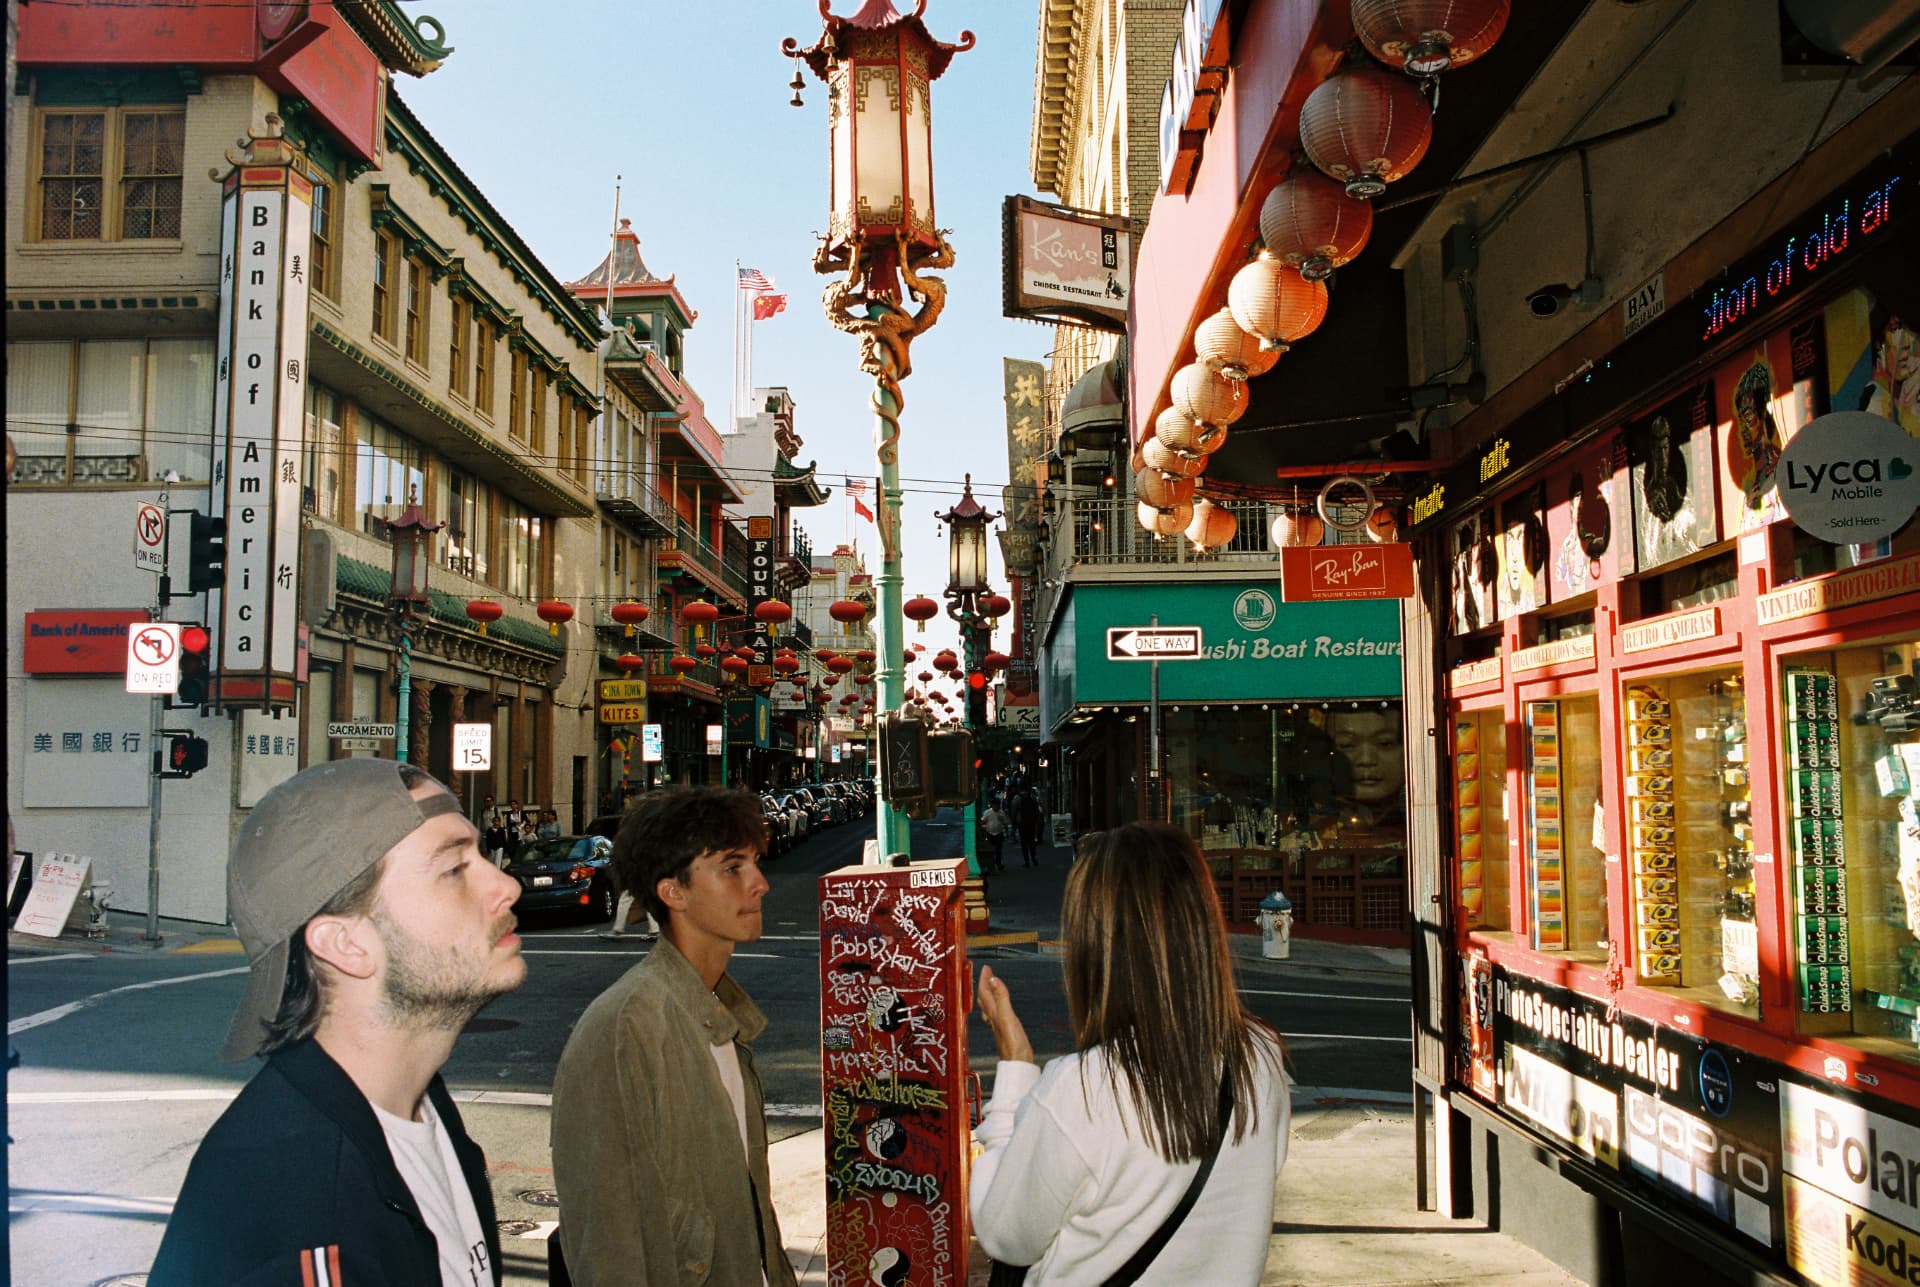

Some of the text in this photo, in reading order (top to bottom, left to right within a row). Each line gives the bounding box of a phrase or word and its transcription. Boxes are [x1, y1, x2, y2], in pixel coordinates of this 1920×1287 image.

[1030, 219, 1098, 269] Kan's
[1767, 236, 1796, 295] of
[1805, 199, 1848, 272] old
[1062, 285, 1102, 298] RESTAURANT
[1627, 279, 1659, 318] BAY
[237, 205, 268, 652] Bank of America
[1786, 459, 1882, 494] Lyca
[1832, 487, 1883, 501] Mobile
[1830, 515, 1880, 528] Sold Here
[138, 550, 162, 565] ON RED
[1315, 551, 1378, 585] Ray-Ban
[753, 540, 768, 664] FOUR EAS
[1760, 586, 1817, 620] VINTAGE
[31, 624, 128, 637] Bank of Americ
[1135, 637, 1191, 650] ONE WAY
[1202, 638, 1247, 661] ushi
[1252, 637, 1307, 660] Boat
[1625, 614, 1713, 650] RETRO CAMERAS
[134, 672, 172, 684] ON RED
[1807, 674, 1817, 720] QuickSnap
[1828, 674, 1838, 720] QuickSnap
[329, 724, 395, 737] SACRAMENTO
[458, 730, 487, 738] SPEED
[604, 708, 639, 721] KITES
[33, 731, 141, 753] 美國銀行
[246, 734, 296, 757] 美國銀行
[461, 738, 484, 746] LIMIT
[463, 748, 483, 765] 15
[1808, 722, 1819, 768] QuickSnap
[1830, 722, 1840, 768] QuickSnap
[1810, 770, 1821, 817] QuickSnap
[1832, 770, 1842, 817] QuickSnap
[1813, 819, 1824, 866] QuickSnap
[1835, 819, 1845, 866] QuickSnap
[1815, 867, 1825, 915] QuickSnap
[1836, 867, 1847, 915] QuickSnap
[828, 934, 867, 964] Bob
[1816, 916, 1827, 964] QuickSnap
[1838, 916, 1848, 964] QuickSnap
[1819, 965, 1830, 1014] QuickSnap
[1840, 965, 1851, 1014] QuickSnap
[1612, 1023, 1681, 1092] Dealer
[1627, 1092, 1769, 1194] GoPro
